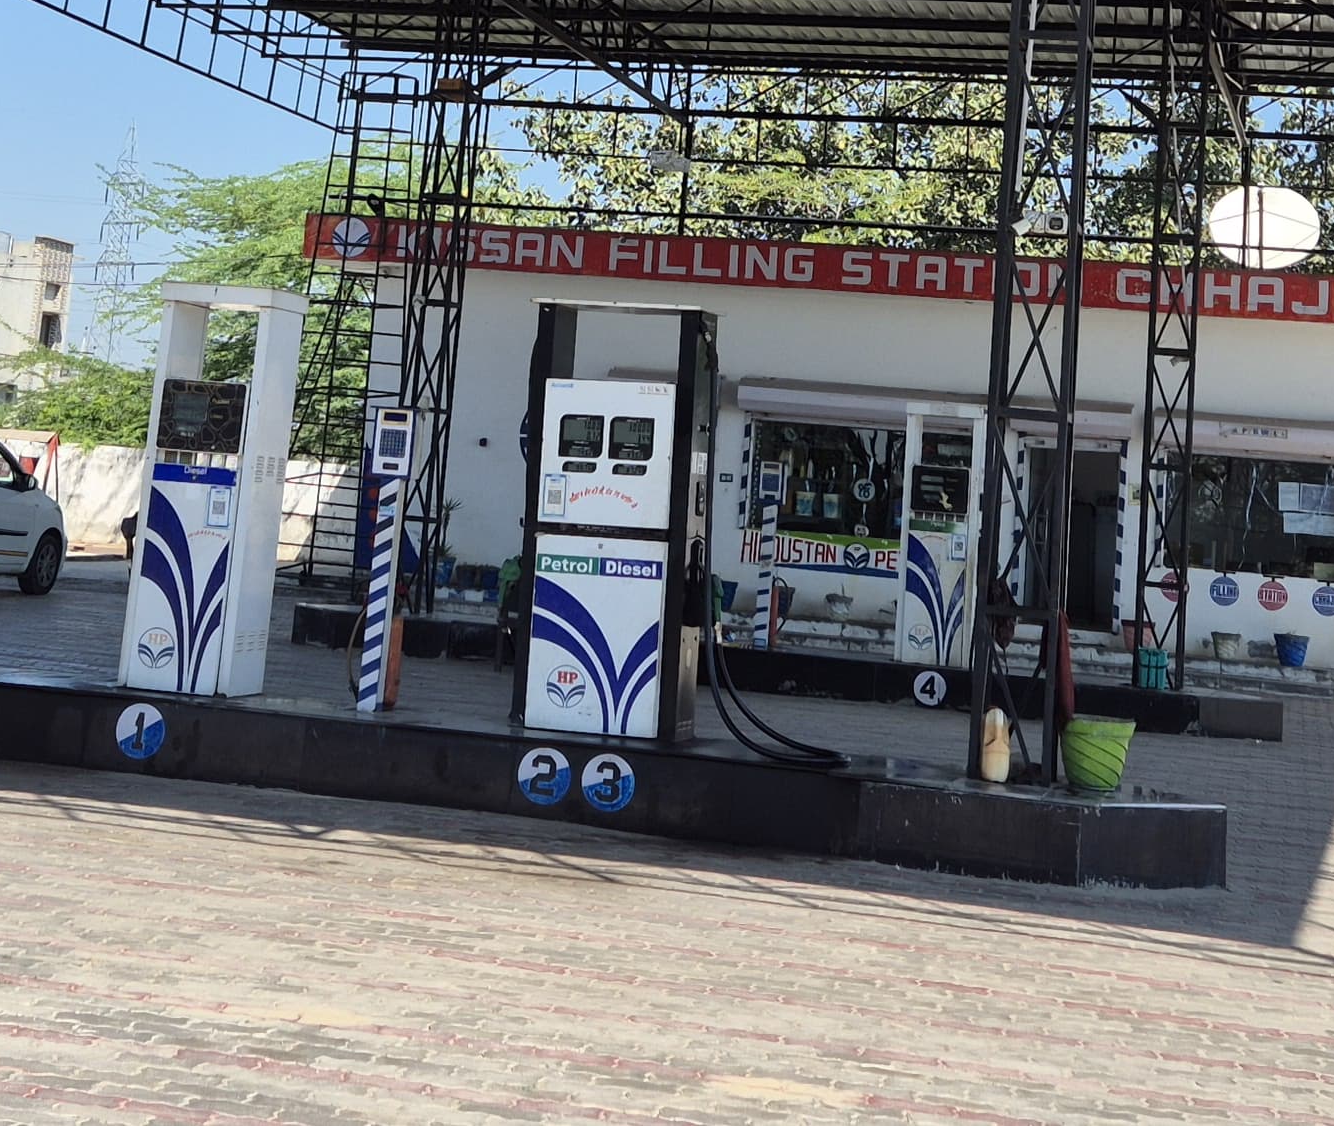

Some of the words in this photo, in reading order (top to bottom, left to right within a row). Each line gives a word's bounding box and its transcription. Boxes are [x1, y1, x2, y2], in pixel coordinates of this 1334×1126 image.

[396, 225, 584, 269] KISSAN
[608, 237, 815, 283] FILLING
[184, 466, 207, 475] Diesel
[541, 556, 593, 572] Petrol
[605, 560, 657, 576] Diesel
[874, 550, 901, 570] PE
[148, 633, 169, 645] HP
[557, 671, 578, 684] HP
[919, 675, 938, 699] 4
[131, 712, 145, 750] 1
[529, 754, 558, 797] 2
[593, 761, 622, 803] 3
